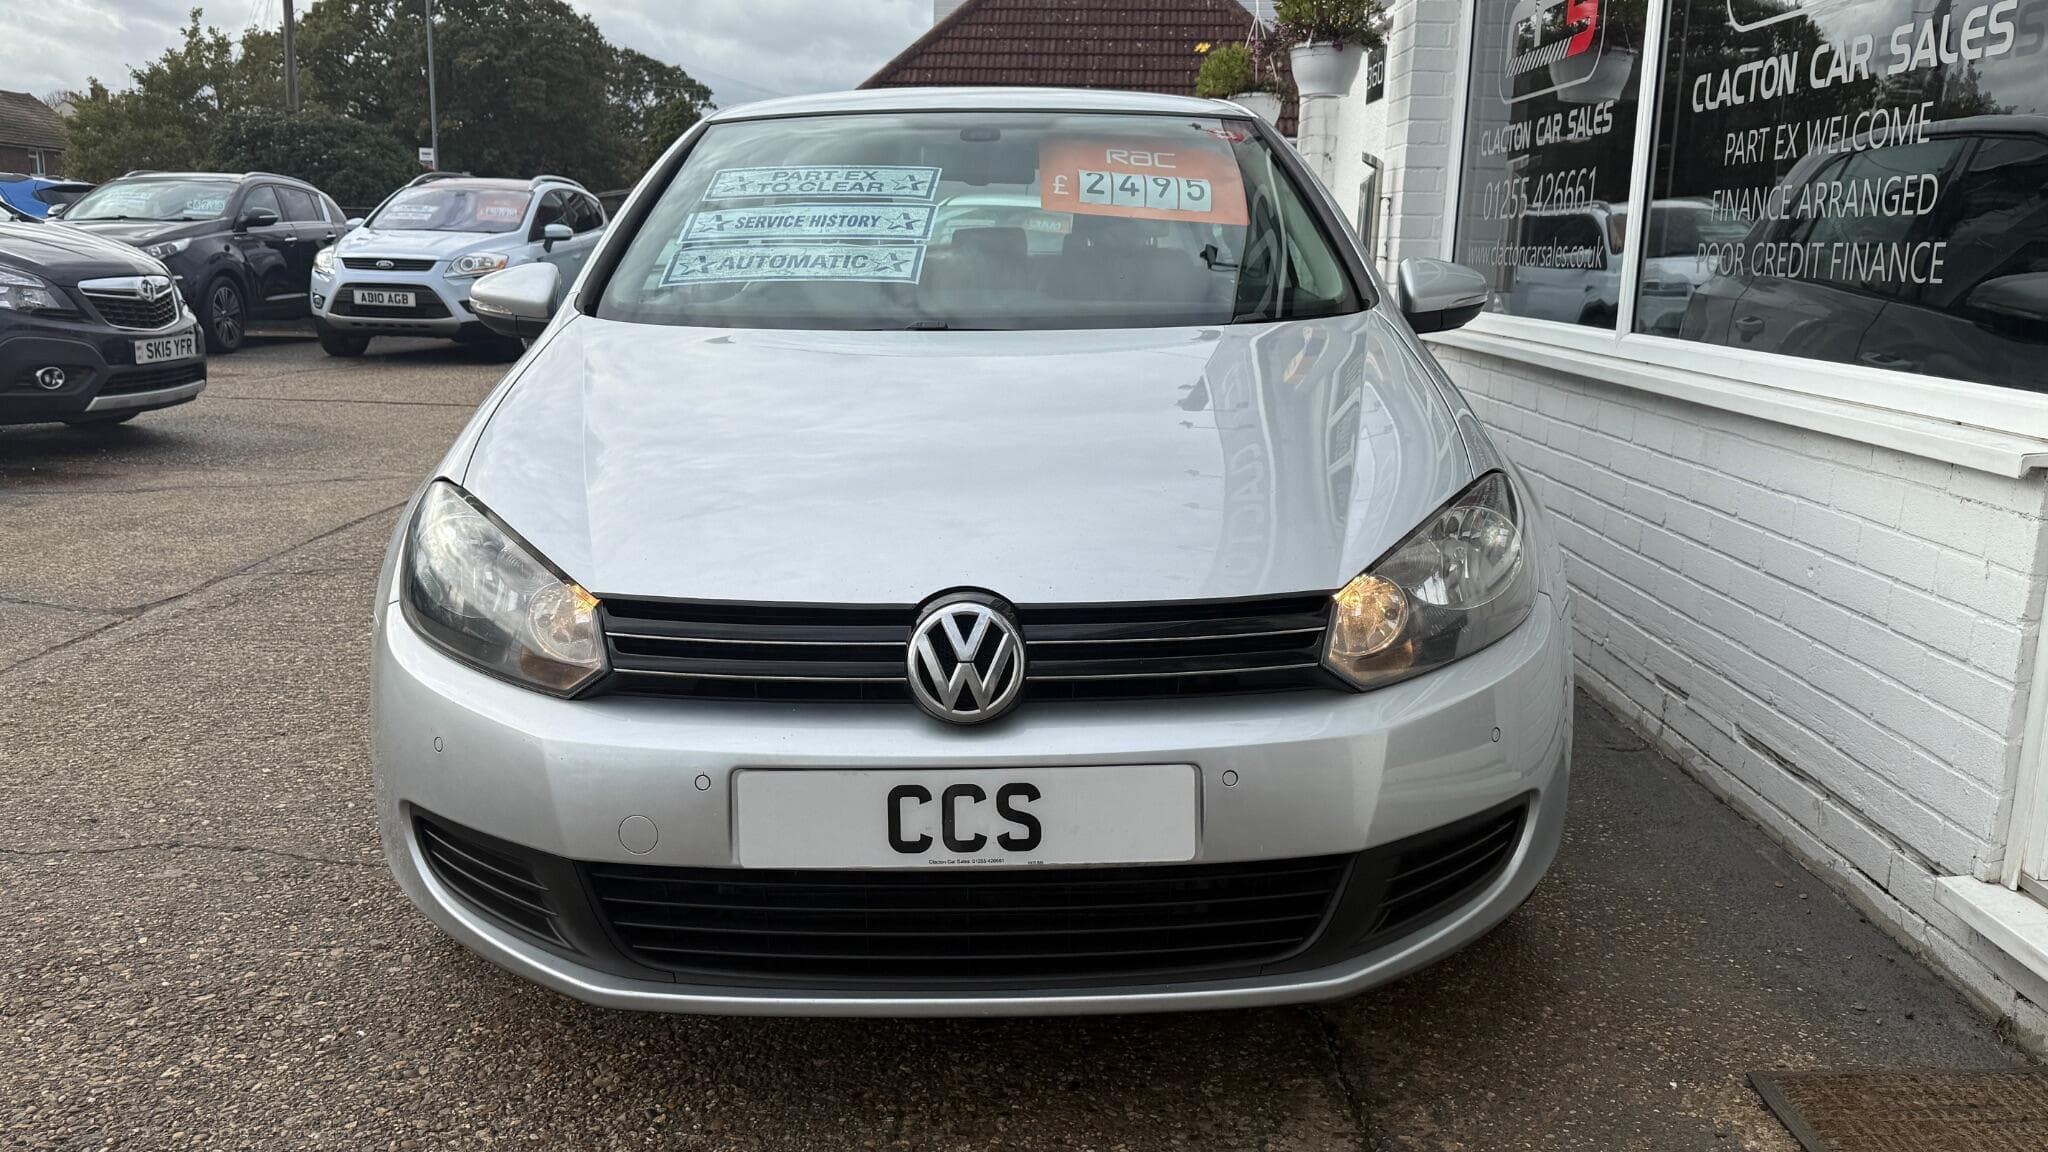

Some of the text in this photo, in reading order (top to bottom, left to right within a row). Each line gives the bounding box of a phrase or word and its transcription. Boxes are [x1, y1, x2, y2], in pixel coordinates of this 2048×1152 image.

[1693, 0, 2017, 113] CLACTON CAR SALES
[1481, 100, 1614, 156] CLACTON CAR SALES
[1724, 101, 1934, 166] PART EX WELCOME
[758, 182, 884, 193] TO CLEAR
[1052, 172, 1205, 201] £ 2495
[1483, 166, 1598, 220] 01255 426661
[1711, 173, 1939, 221] FINANCE ARRANGED
[735, 214, 882, 229] SERVICE HISTORY
[717, 254, 870, 270] AUTOMATIC
[1468, 236, 1604, 268] www.clactoncarsales.co.uk
[1695, 241, 1947, 284] POOR CREDIT FINANCE
[387, 293, 408, 305] AGB
[146, 338, 192, 359] SK15 YFR
[887, 782, 1042, 854] CCS
